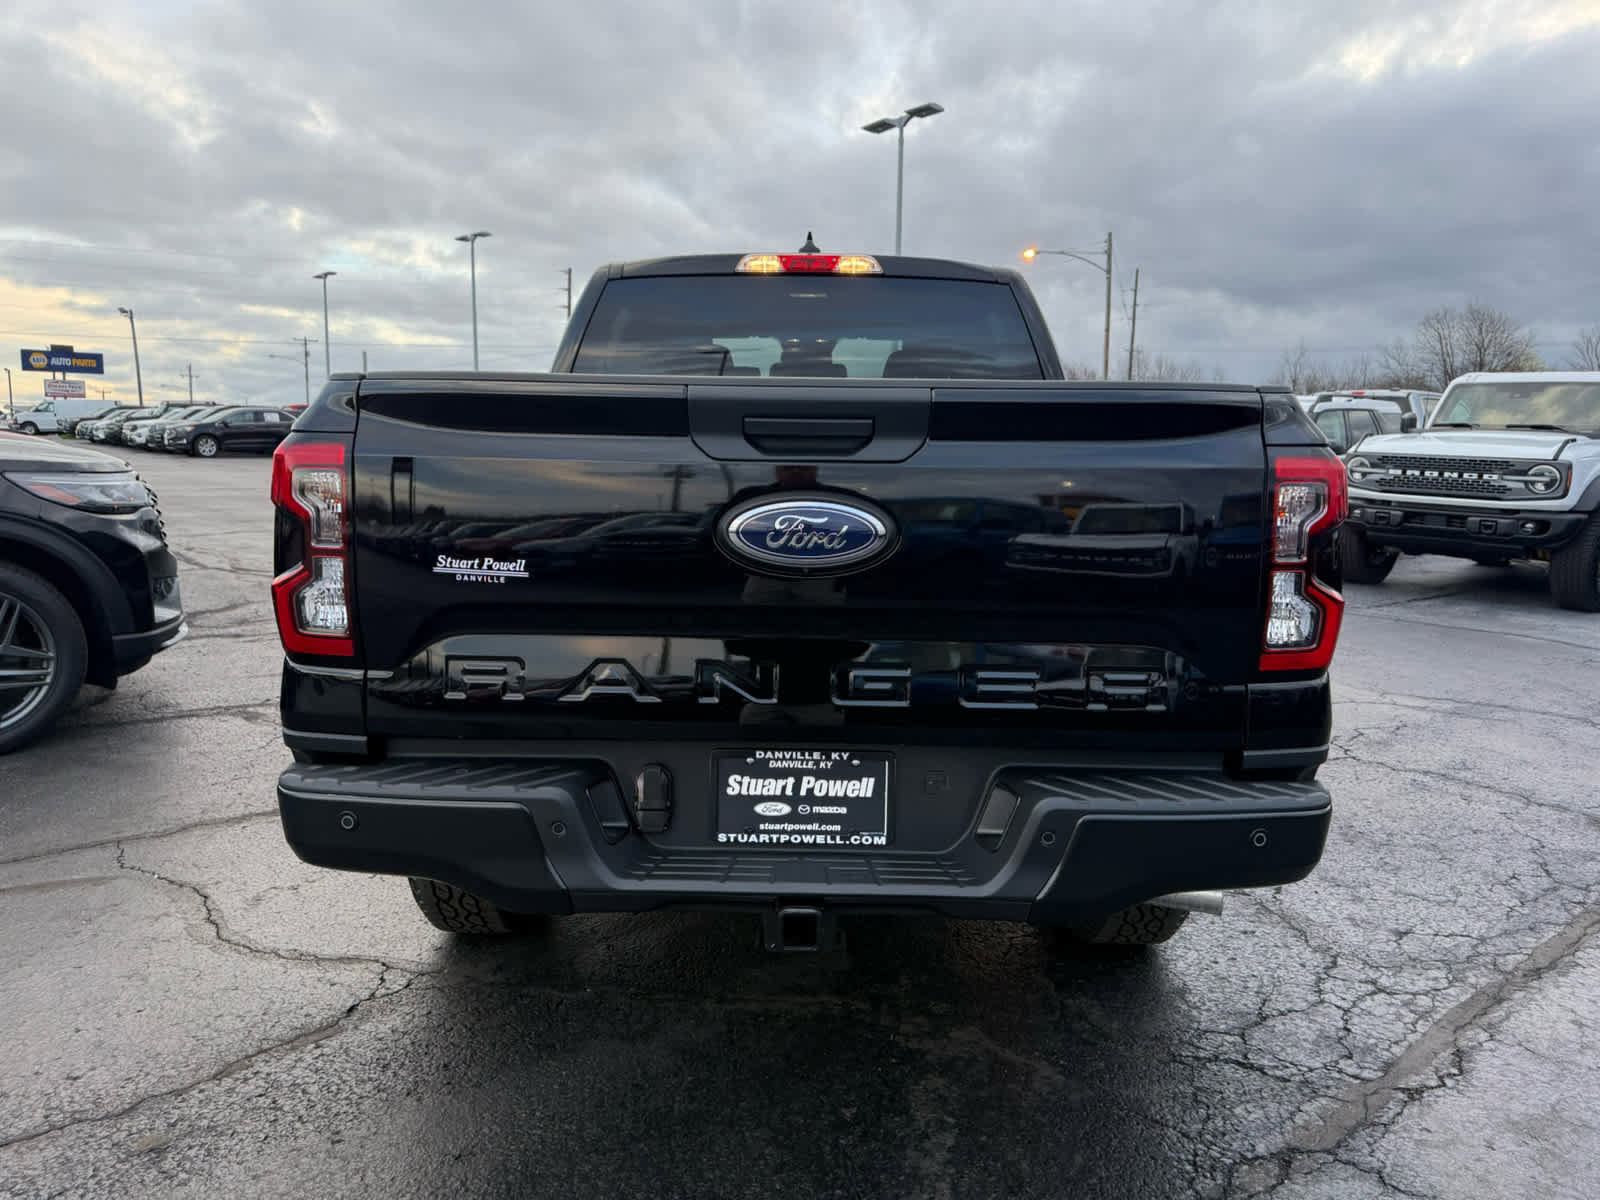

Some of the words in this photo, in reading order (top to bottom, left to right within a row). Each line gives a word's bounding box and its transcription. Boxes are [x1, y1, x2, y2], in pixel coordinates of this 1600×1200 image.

[50, 357, 71, 366] AUTO
[1388, 468, 1499, 480] BRONCO
[766, 515, 848, 549] Ford
[436, 554, 480, 569] Stuart
[482, 558, 526, 571] Powell
[456, 574, 505, 584] DANVILLE
[443, 655, 1168, 712] RANGER
[755, 751, 825, 760] DANVILLE,
[831, 752, 850, 760] KY
[769, 761, 817, 770] DANVILLE,
[819, 761, 833, 769] KY
[726, 774, 795, 796] Stuart
[800, 776, 875, 797] Powell
[761, 803, 784, 814] Ford
[759, 822, 841, 832] stuartpowell.com
[717, 833, 887, 845] STUARTPOWELL.COM
